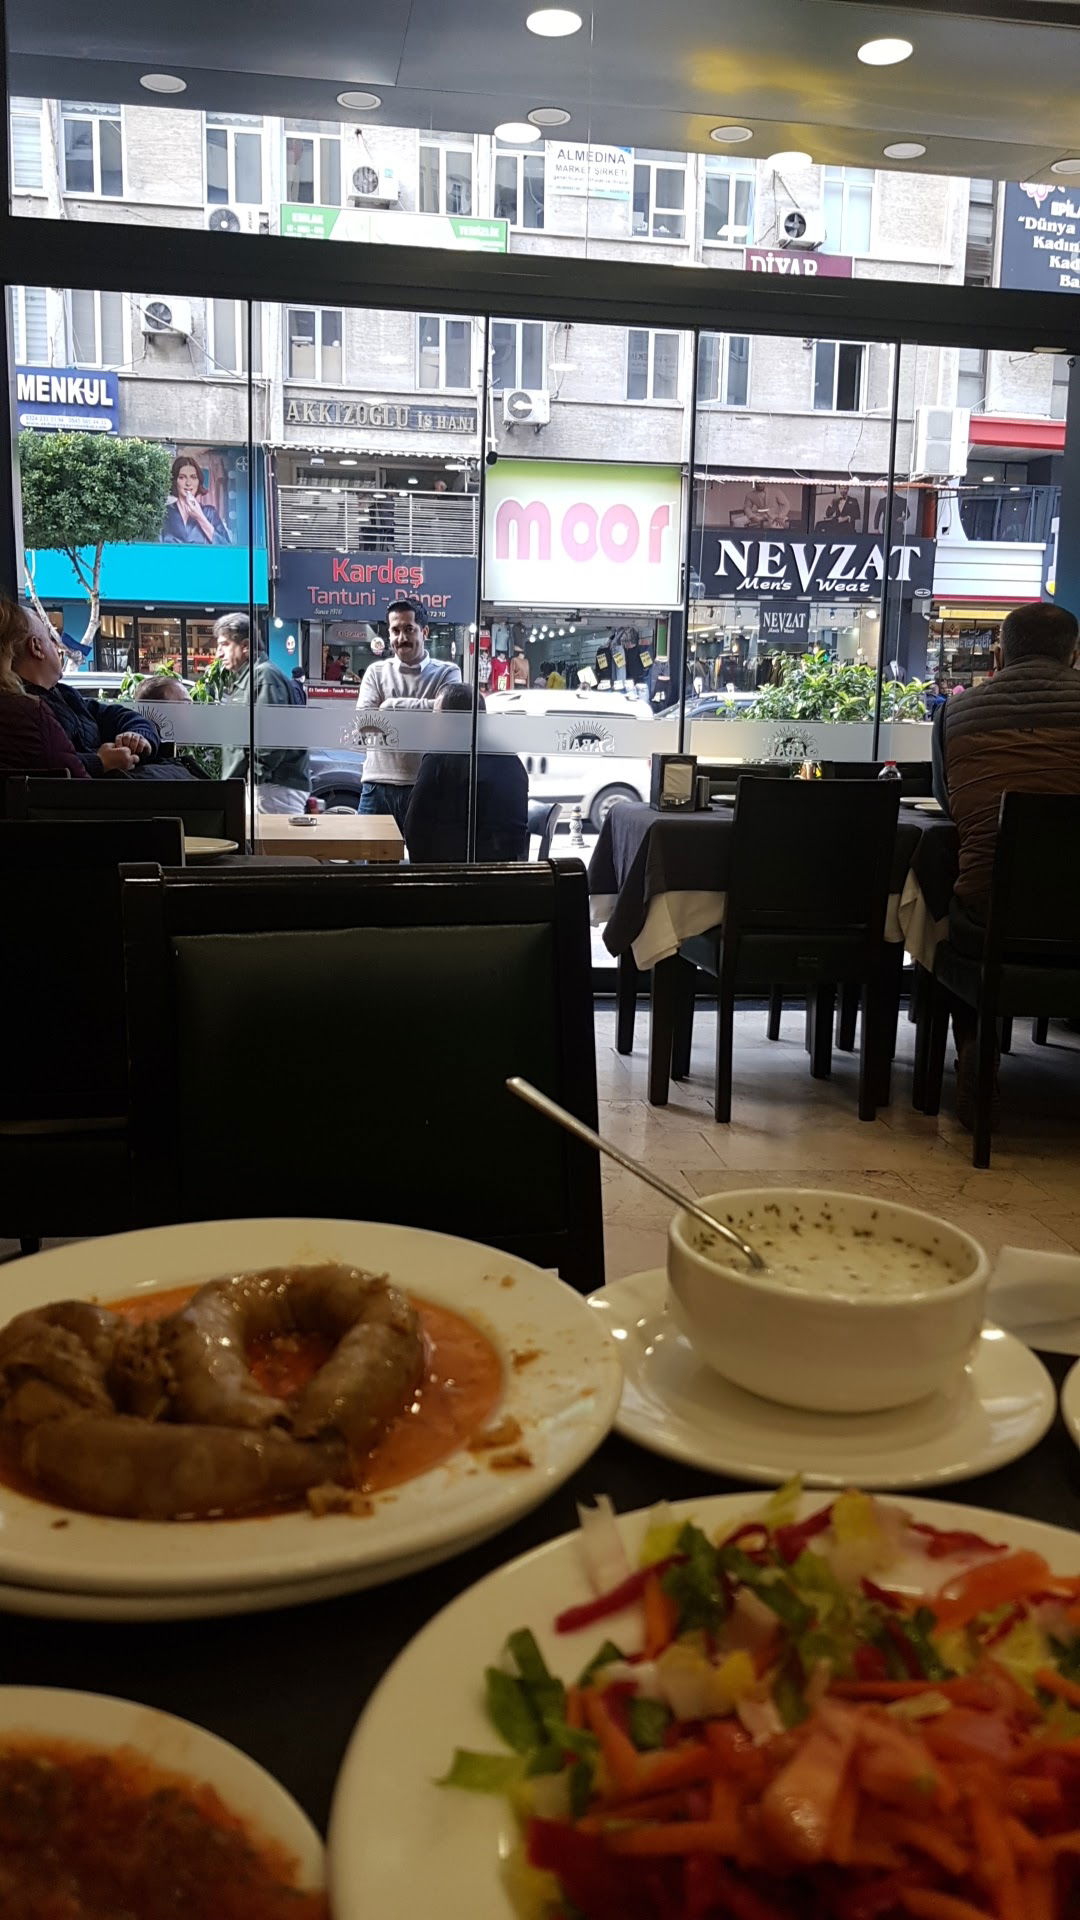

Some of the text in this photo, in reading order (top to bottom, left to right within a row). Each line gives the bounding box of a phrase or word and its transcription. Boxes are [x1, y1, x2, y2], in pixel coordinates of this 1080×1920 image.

[557, 149, 626, 164] ALMEDINA
[555, 164, 591, 174] MARKET
[16, 373, 113, 406] MENKUL
[495, 499, 670, 564] moor
[332, 557, 424, 588] Kardeş
[714, 539, 921, 592] NEVZAT
[736, 577, 871, 592] Men's Wear
[307, 586, 376, 606] Tantuni
[394, 588, 452, 608] Döner
[763, 612, 806, 633] NEVZAT
